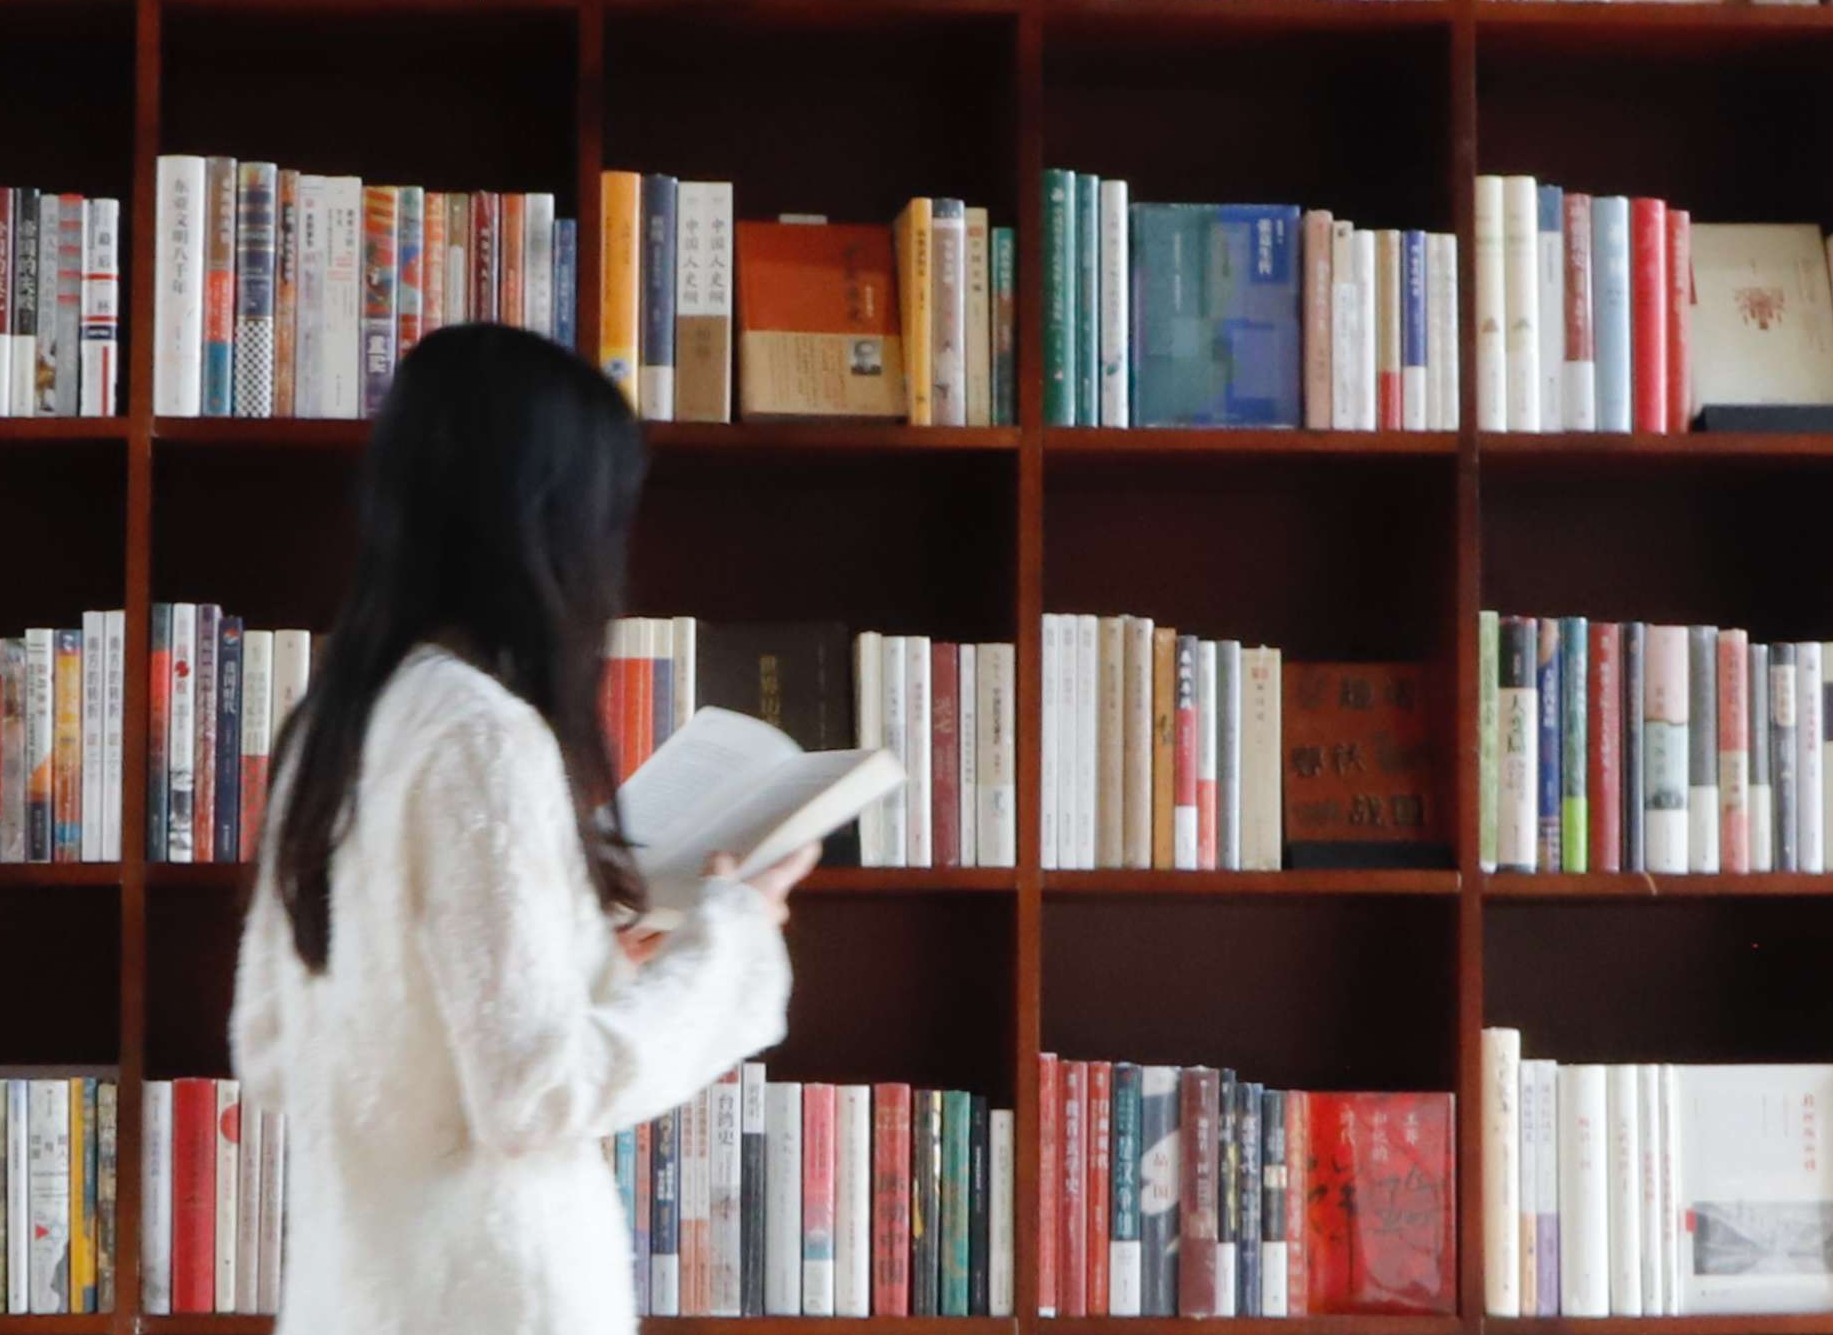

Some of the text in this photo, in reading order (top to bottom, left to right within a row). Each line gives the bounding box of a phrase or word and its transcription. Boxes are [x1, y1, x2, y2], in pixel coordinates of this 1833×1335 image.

[683, 219, 700, 305] 中国人史纲
[709, 219, 725, 305] 中国人史纲
